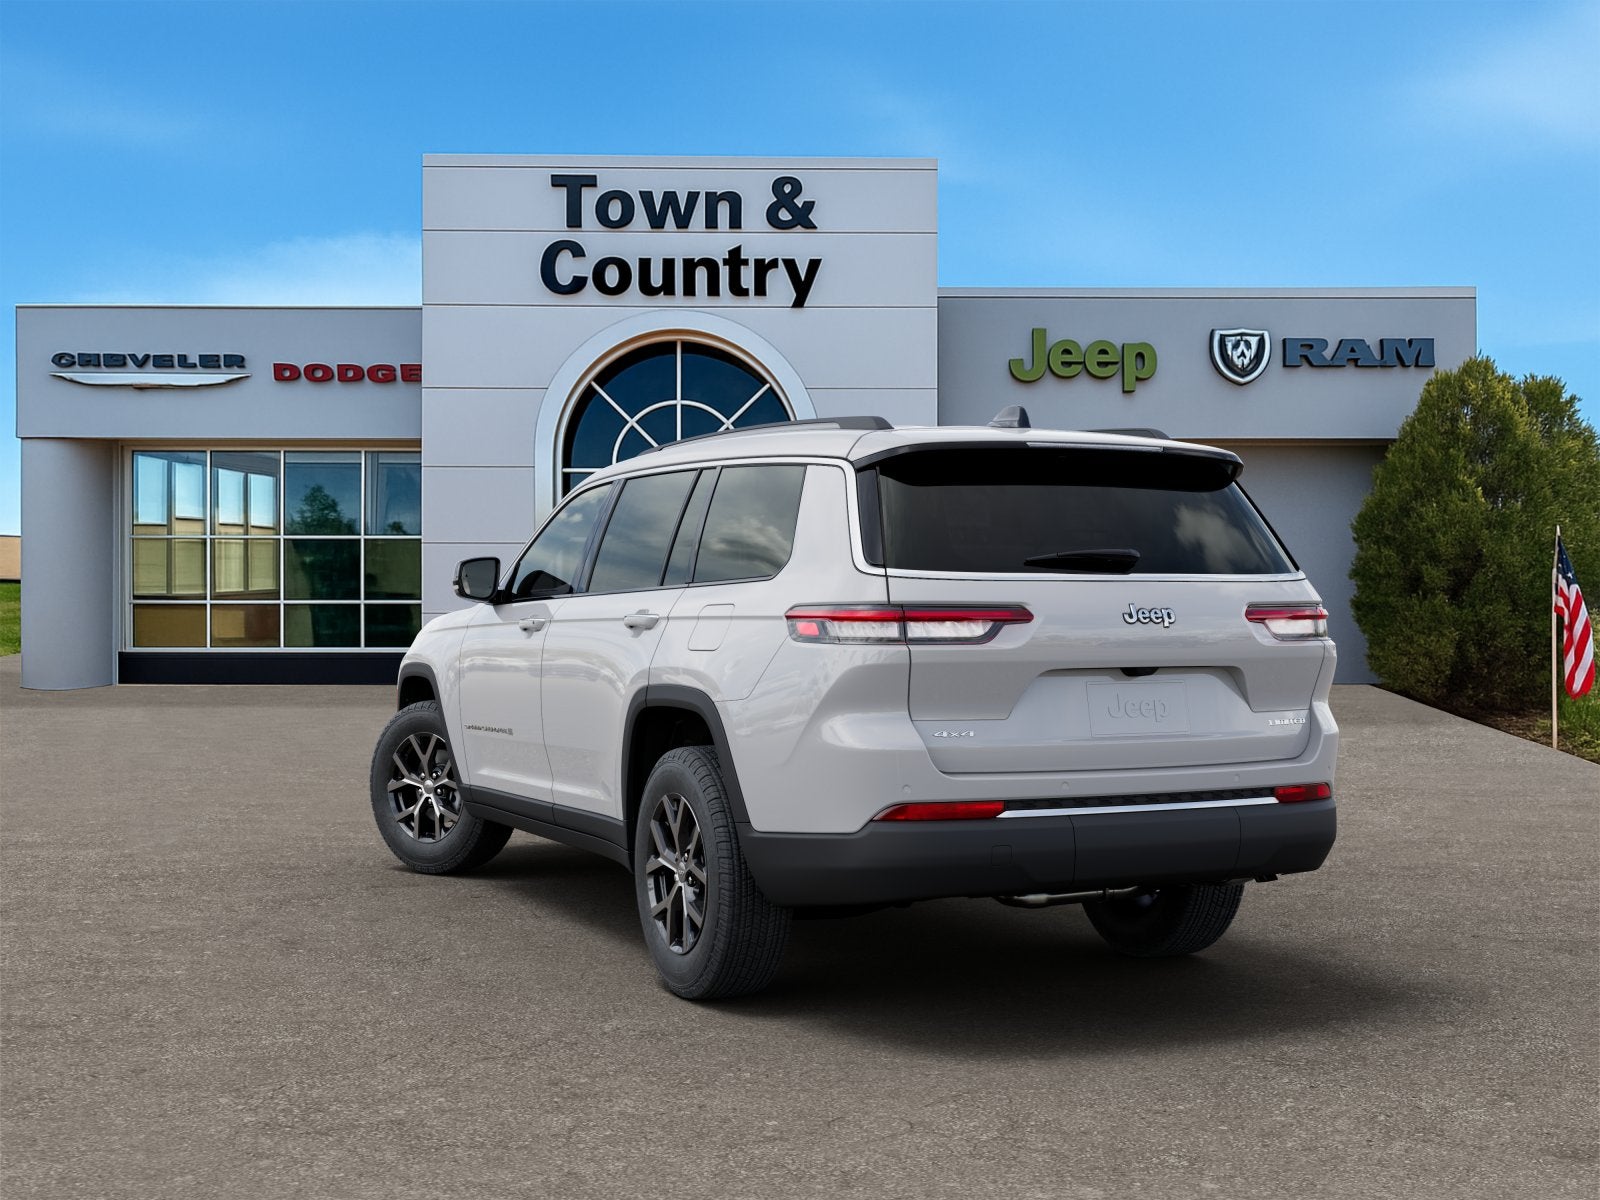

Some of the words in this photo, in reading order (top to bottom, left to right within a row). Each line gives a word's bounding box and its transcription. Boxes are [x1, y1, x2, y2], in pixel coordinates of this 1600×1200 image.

[551, 174, 742, 229] Town
[765, 176, 818, 230] &
[540, 240, 822, 308] Country
[1009, 328, 1158, 393] Jeep
[1283, 338, 1435, 367] RAM
[273, 363, 422, 383] DODGE
[1123, 603, 1176, 628] Jeep
[1106, 689, 1169, 723] Jeep
